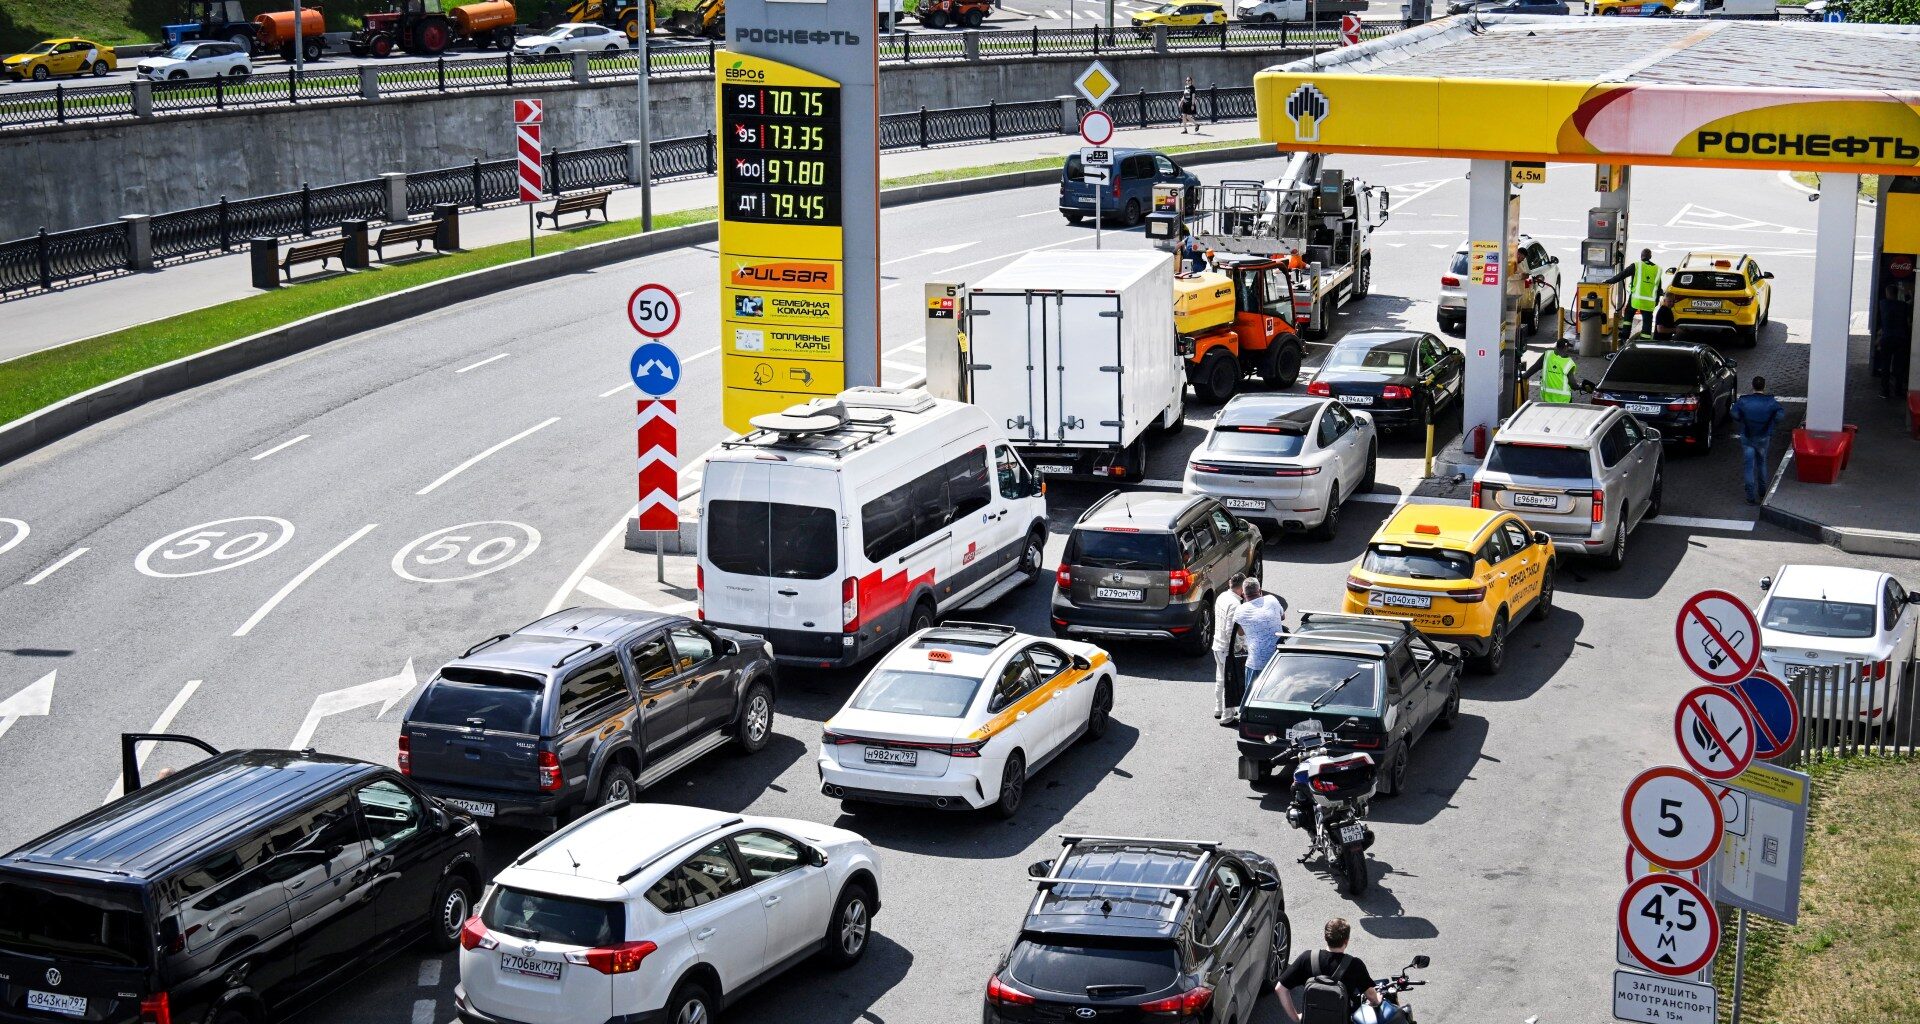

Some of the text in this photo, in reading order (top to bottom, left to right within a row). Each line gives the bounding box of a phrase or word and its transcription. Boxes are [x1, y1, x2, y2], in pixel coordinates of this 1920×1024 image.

[736, 28, 860, 46] РОСНЕФТЬ
[725, 68, 765, 79] ЕВРО 6
[738, 90, 823, 116] 95 70.75
[739, 124, 823, 151] 95 73.35
[1697, 131, 1920, 160] РОСНЕФТЬ
[738, 159, 825, 185] 100 97.80
[1170, 188, 1178, 197] 6
[739, 193, 824, 220] ДТ 79.45
[946, 286, 956, 297] 5
[639, 300, 668, 322] 50
[771, 298, 830, 309] СЕМЕЙНАЯ
[777, 306, 830, 317] КОМАНДА
[770, 332, 830, 343] ТОПЛИВНЫЕ
[795, 341, 830, 350] КАРТЫ
[163, 531, 269, 560] 50
[416, 536, 516, 566] 50
[1370, 591, 1383, 604] Z
[1657, 798, 1684, 838] 5
[1641, 894, 1697, 932] 4,5
[1632, 981, 1698, 1000] ЗАГЛУШИТЬ
[1617, 991, 1712, 1014] МОТОТРАНСПОРТ
[1646, 1007, 1683, 1021] ЗА 15м
